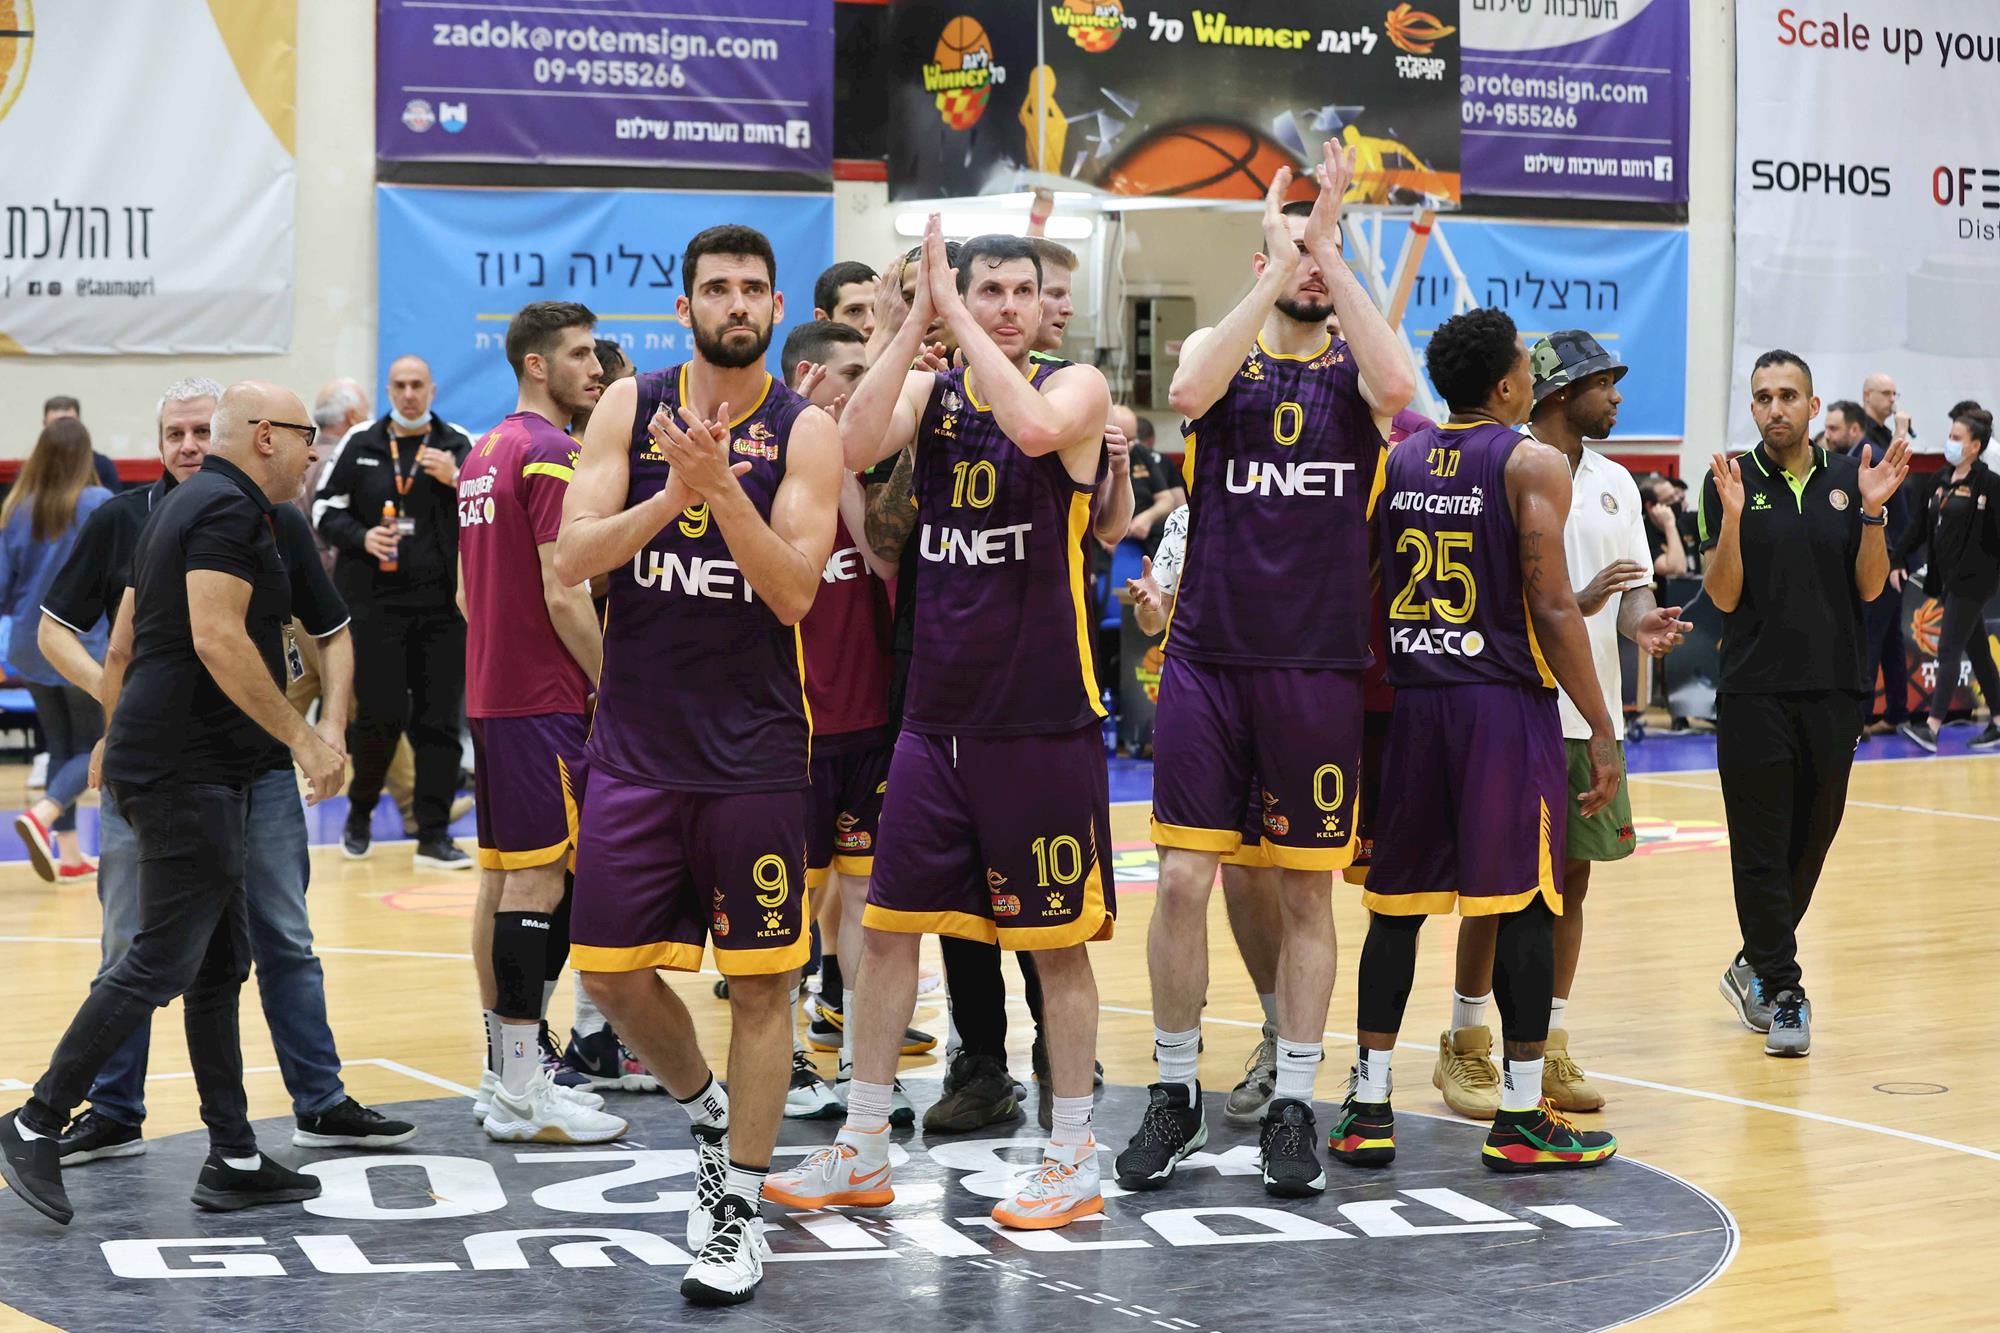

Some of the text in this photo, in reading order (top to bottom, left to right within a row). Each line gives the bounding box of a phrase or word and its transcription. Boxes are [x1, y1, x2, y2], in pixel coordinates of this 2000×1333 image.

[1051, 6, 1119, 28] Winner
[1148, 10, 1377, 54] ליגת Winner סל
[1777, 8, 1870, 51] Scale
[1883, 27, 1923, 65] up
[433, 19, 778, 60] zadok@rotemsign.com
[534, 57, 686, 88] 09-9555266
[923, 64, 988, 91] Winner
[1462, 101, 1578, 129] 09-9555266
[1752, 160, 1891, 197] SOPHOS
[4, 198, 153, 258] זו הולכת
[476, 244, 677, 288] צליה ניוז
[1415, 271, 1618, 311] הרצליה יוז
[1273, 402, 1304, 446] 0
[640, 452, 667, 461] KELM
[951, 460, 996, 508] 10
[1390, 491, 1481, 516] AUTO CENTER
[1389, 528, 1477, 624] 25
[1390, 626, 1485, 657] KASCO
[1313, 763, 1343, 812] 0
[752, 853, 789, 908] 9
[1031, 834, 1083, 887] 10
[1041, 908, 1072, 917] KELME
[757, 928, 791, 938] KELME
[1360, 1059, 1369, 1080] NIKE
